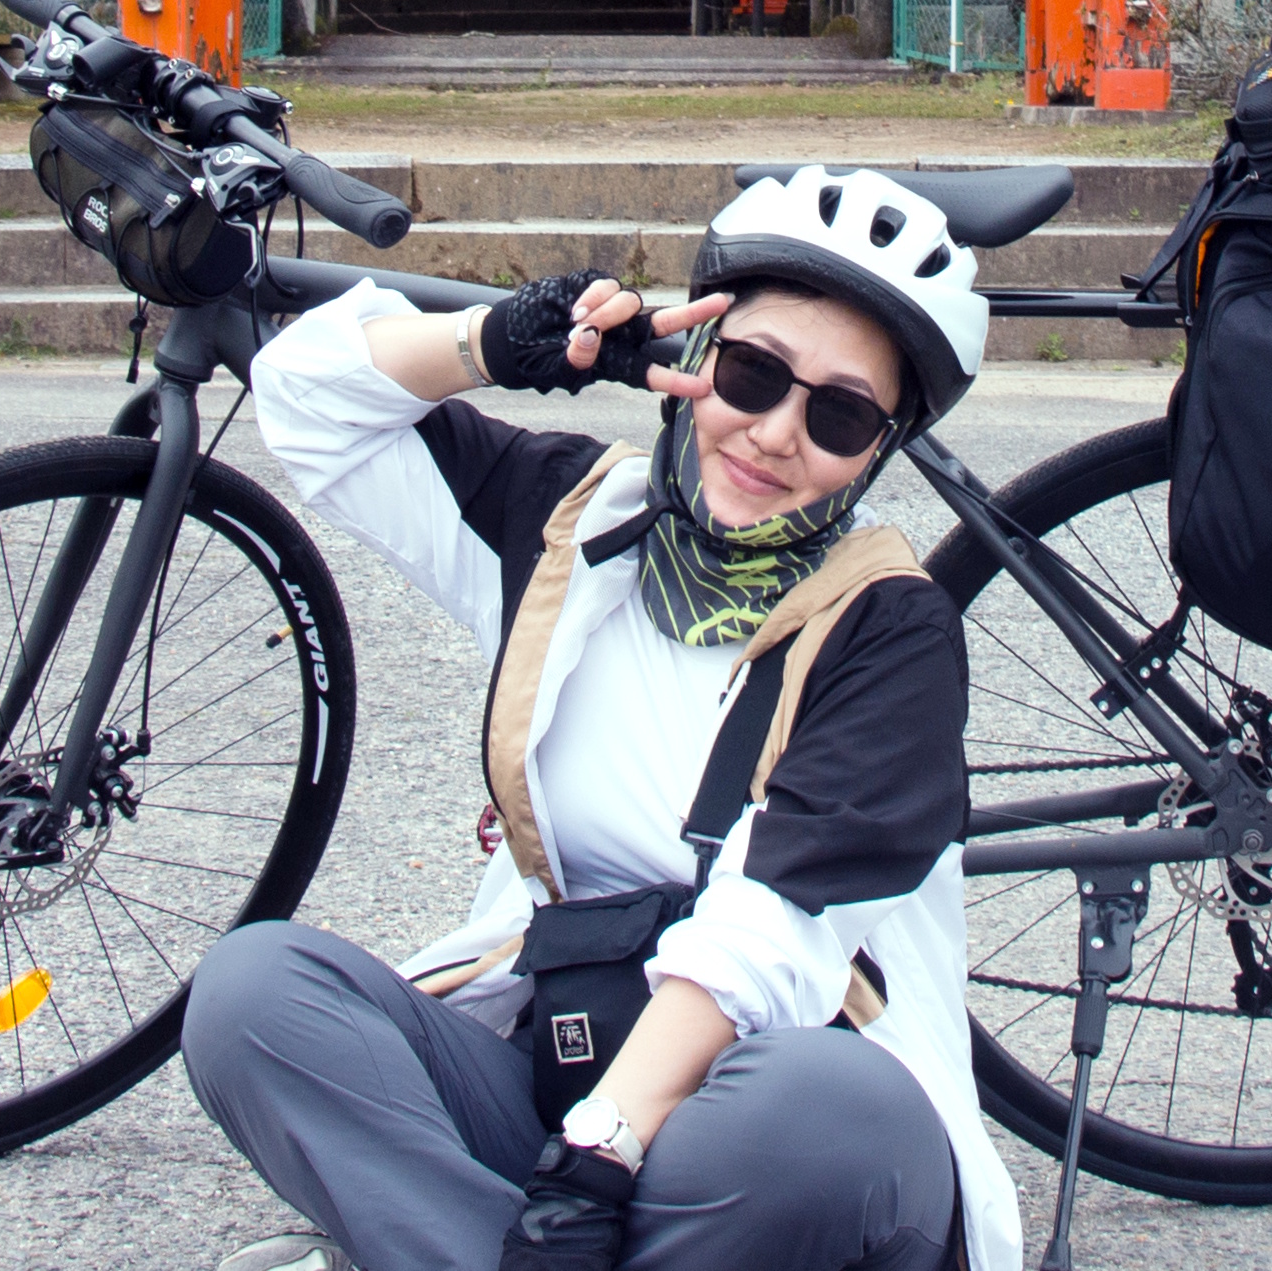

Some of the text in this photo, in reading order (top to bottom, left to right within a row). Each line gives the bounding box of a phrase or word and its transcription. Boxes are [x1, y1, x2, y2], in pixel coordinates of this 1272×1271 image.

[83, 207, 108, 233] BROS
[88, 195, 113, 219] ROC
[281, 578, 329, 694] GIANT
